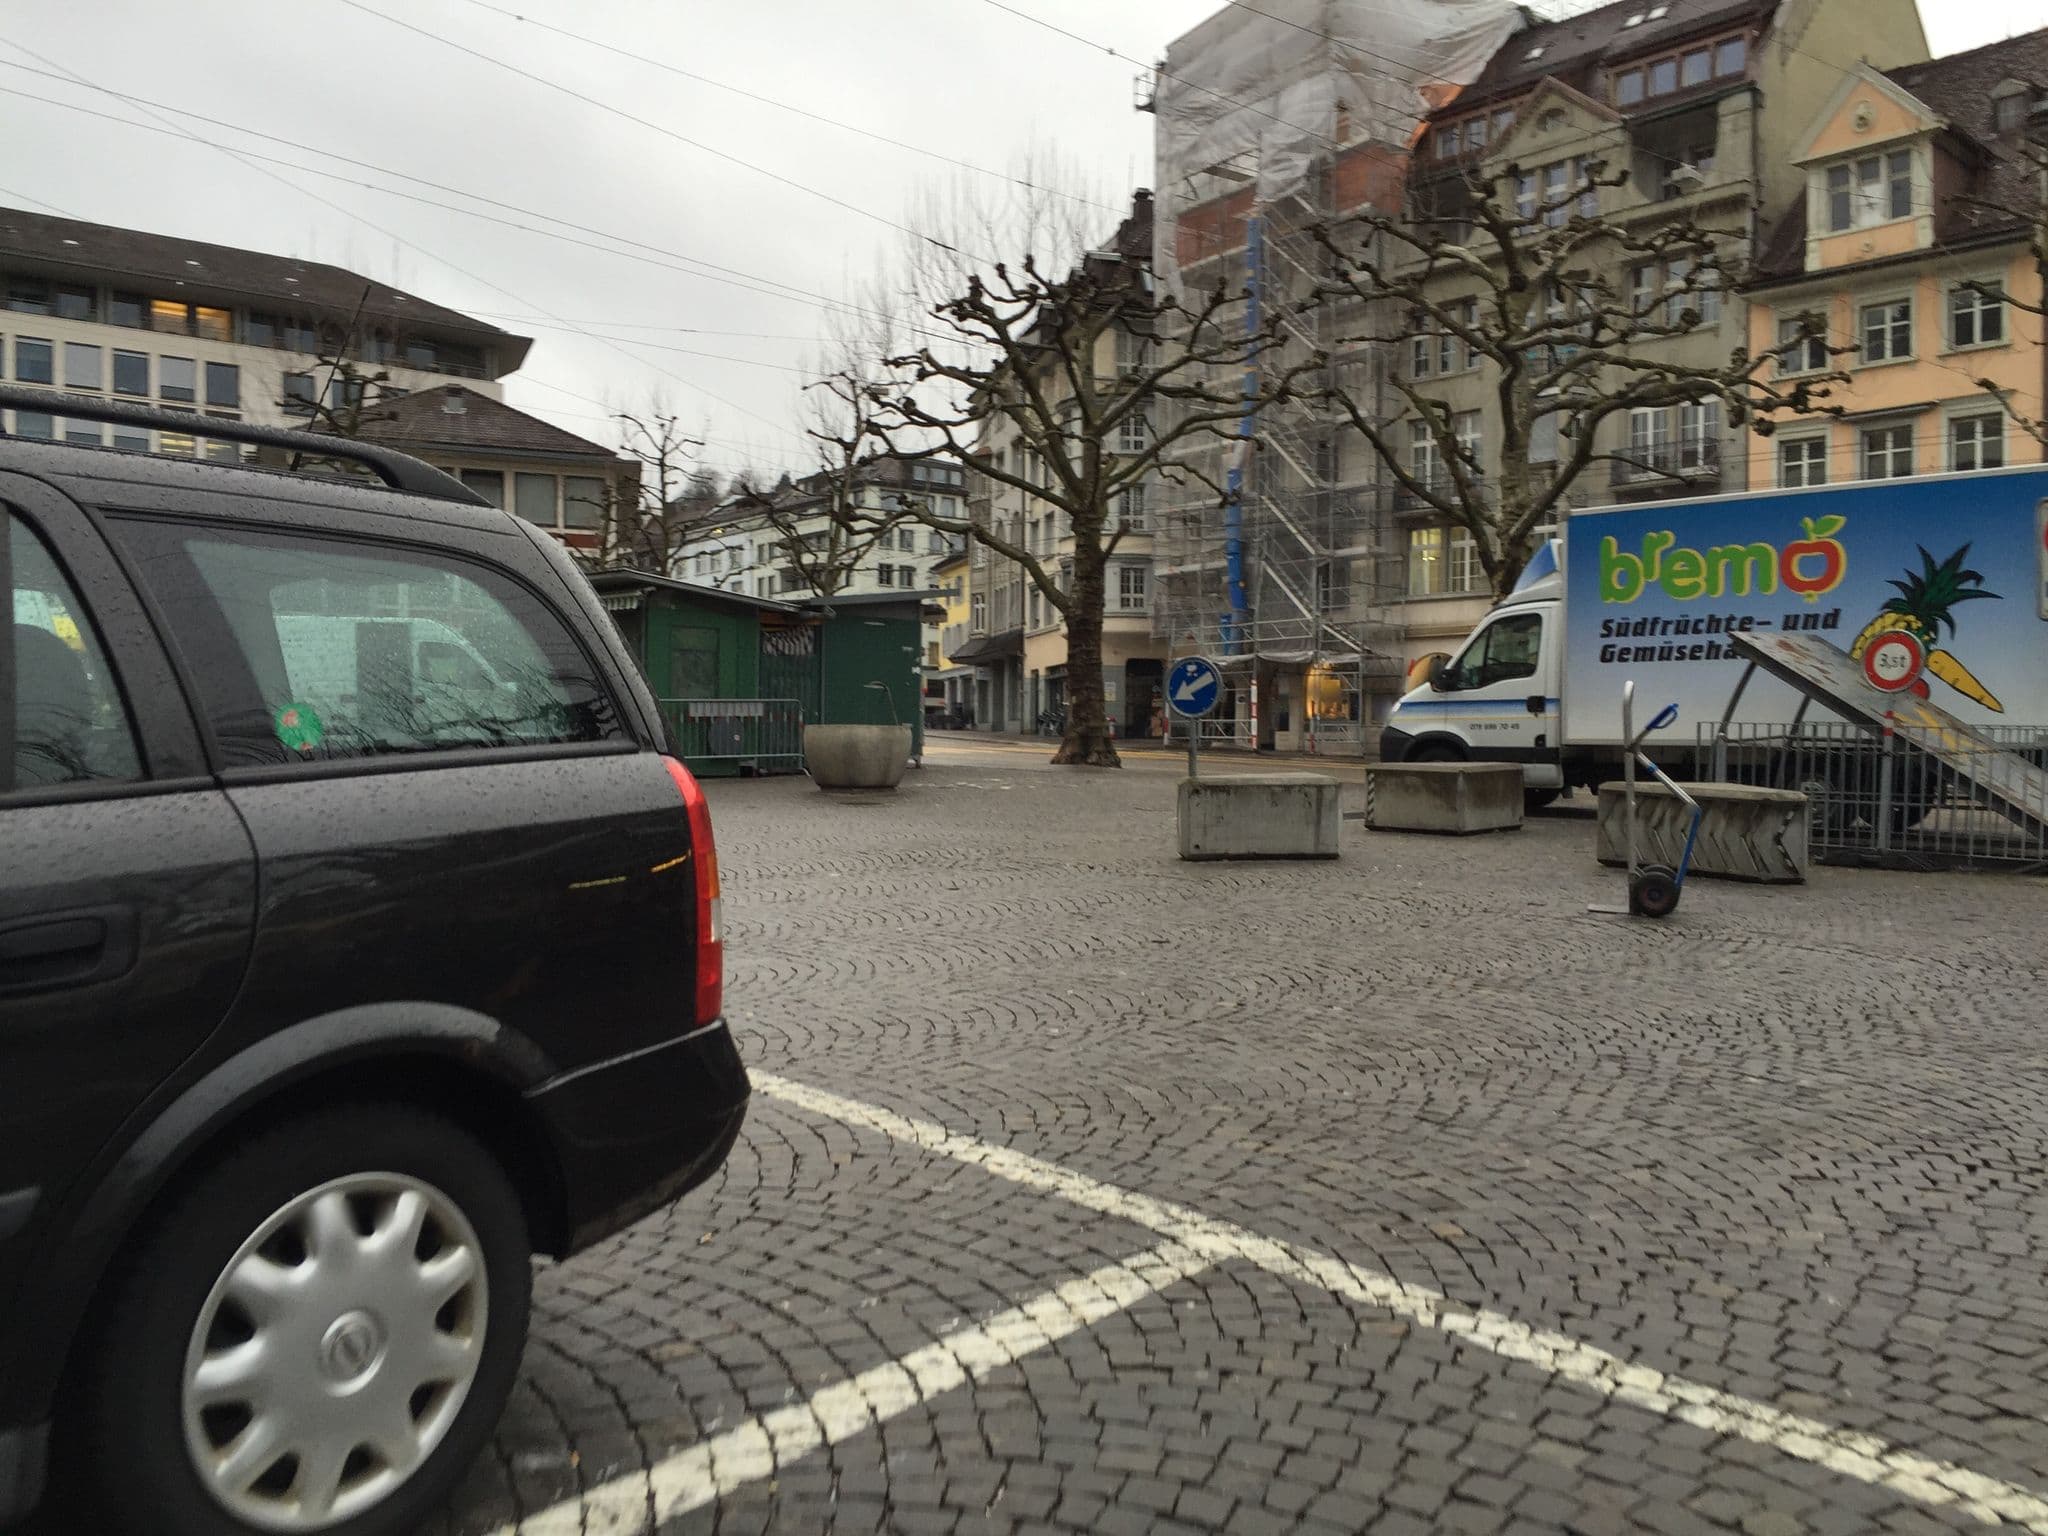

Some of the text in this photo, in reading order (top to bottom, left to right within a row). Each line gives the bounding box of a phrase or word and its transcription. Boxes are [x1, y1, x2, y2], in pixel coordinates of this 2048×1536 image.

[1600, 515, 1847, 604] bremo
[1600, 608, 1841, 639] Südfrüchte- und
